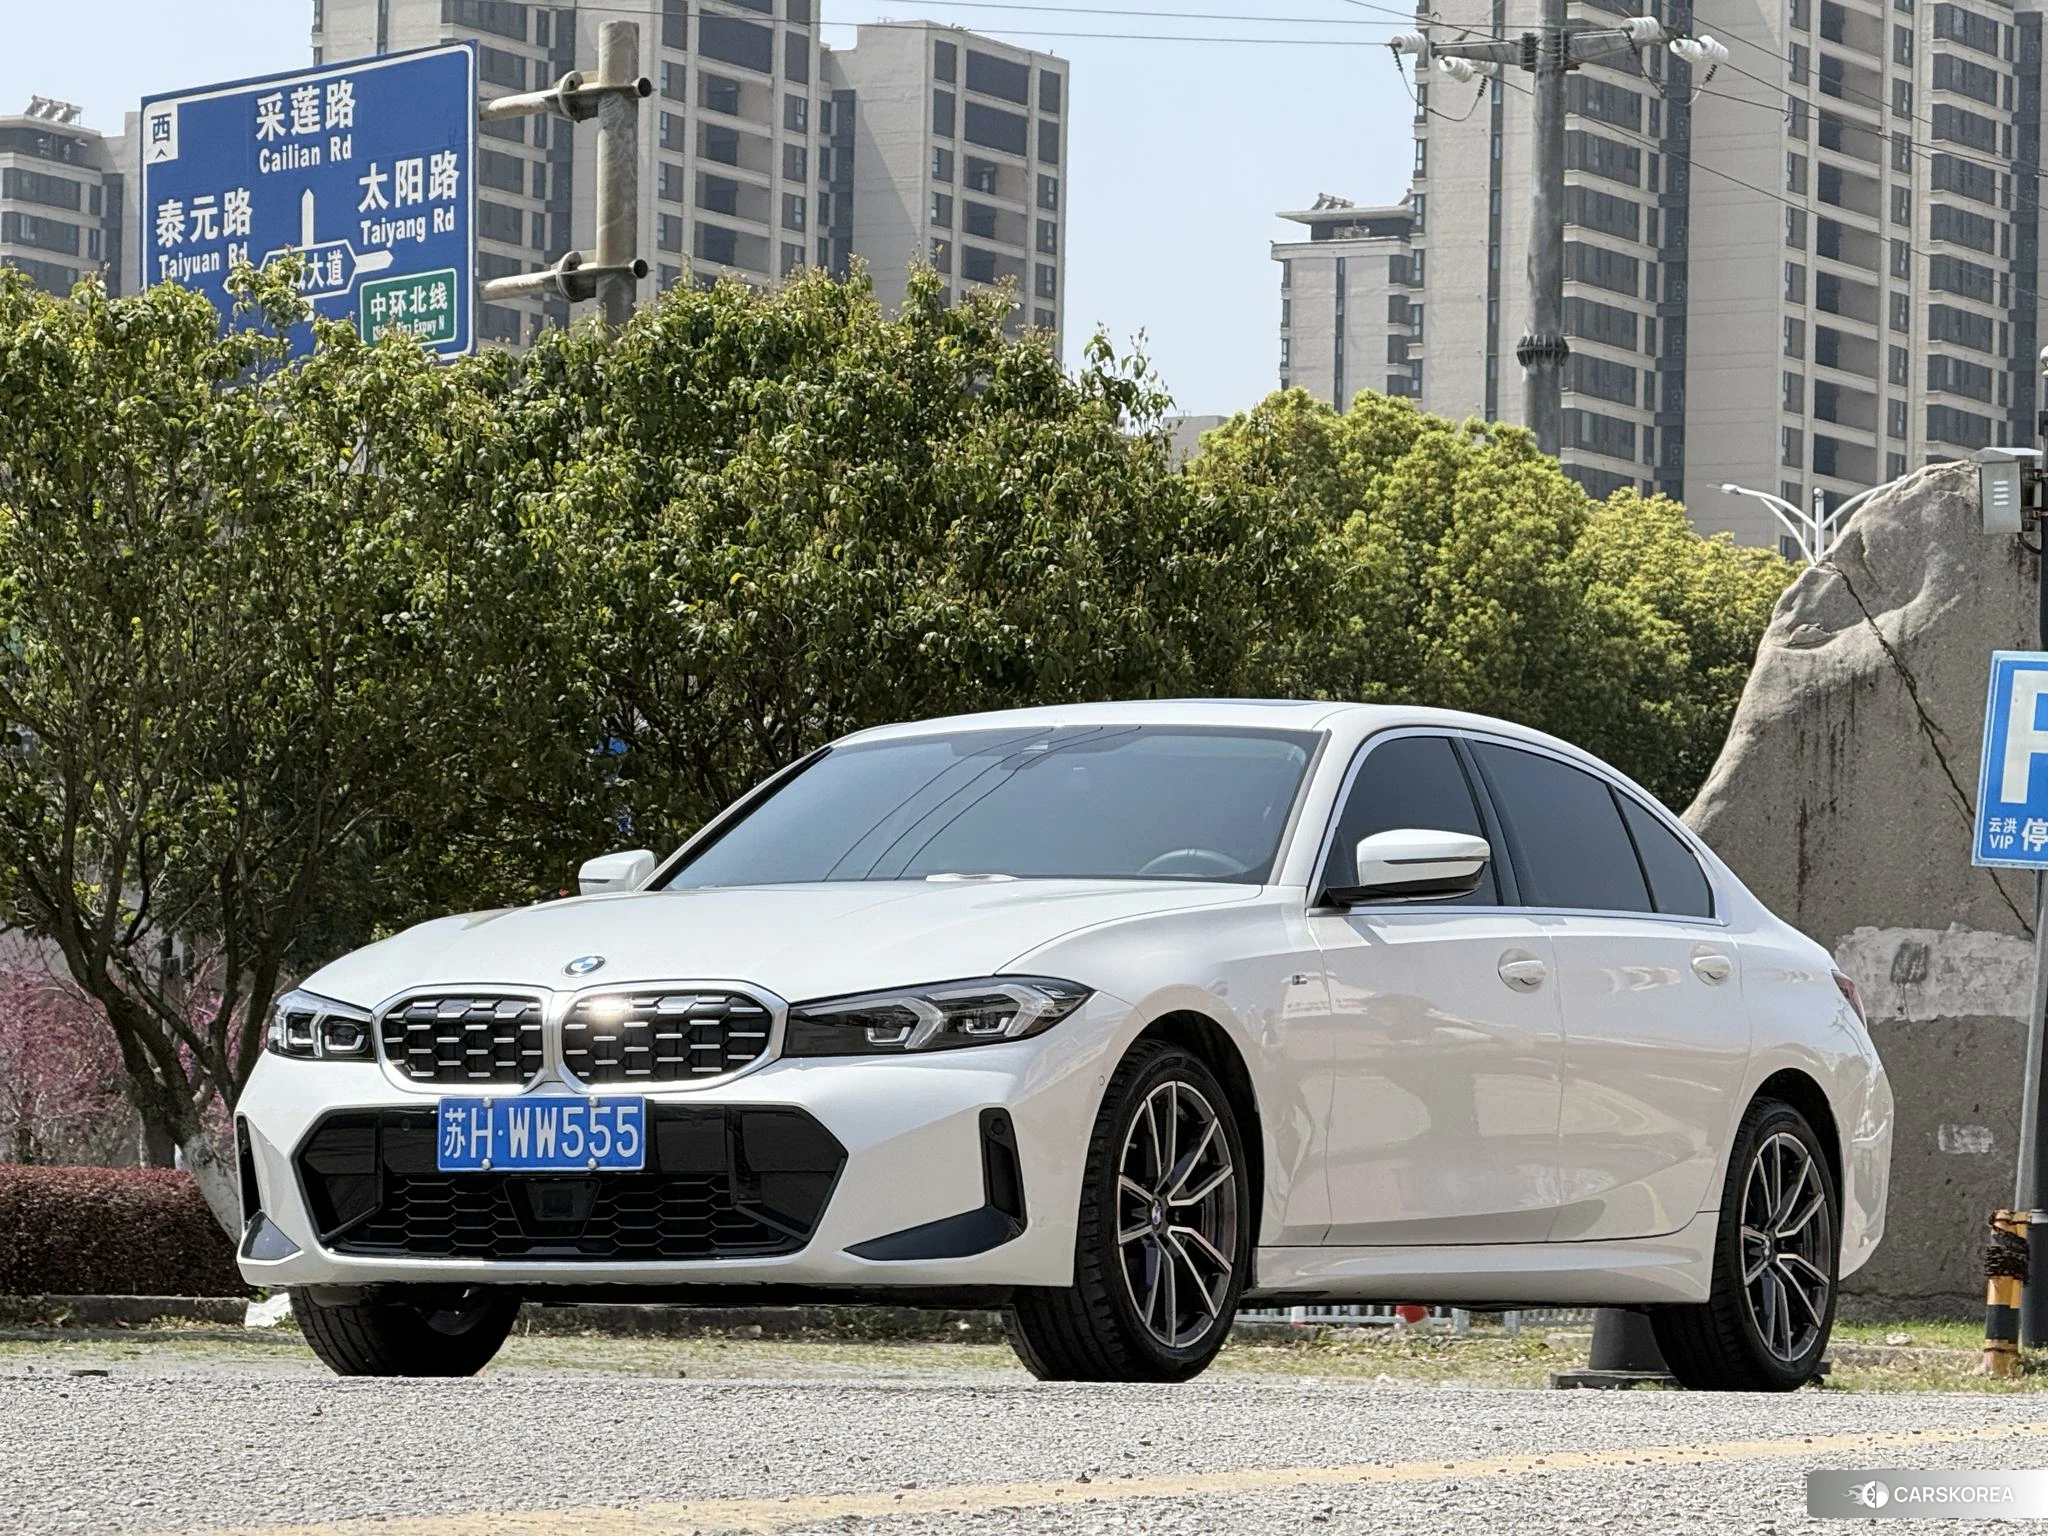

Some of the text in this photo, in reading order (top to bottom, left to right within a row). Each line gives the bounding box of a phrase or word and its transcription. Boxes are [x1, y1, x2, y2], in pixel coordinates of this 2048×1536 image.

[150, 112, 172, 145] 西
[256, 79, 356, 142] 采莲路
[259, 133, 352, 174] Cailian Rd
[357, 149, 460, 214] 太阳路
[155, 187, 253, 248] 泰元路
[360, 205, 455, 248] Taiyang Rd
[158, 241, 248, 282] Taiyuan Rd
[370, 282, 448, 322] 中环北线
[1989, 834, 2014, 850] VIP
[2021, 816, 2048, 853] 停
